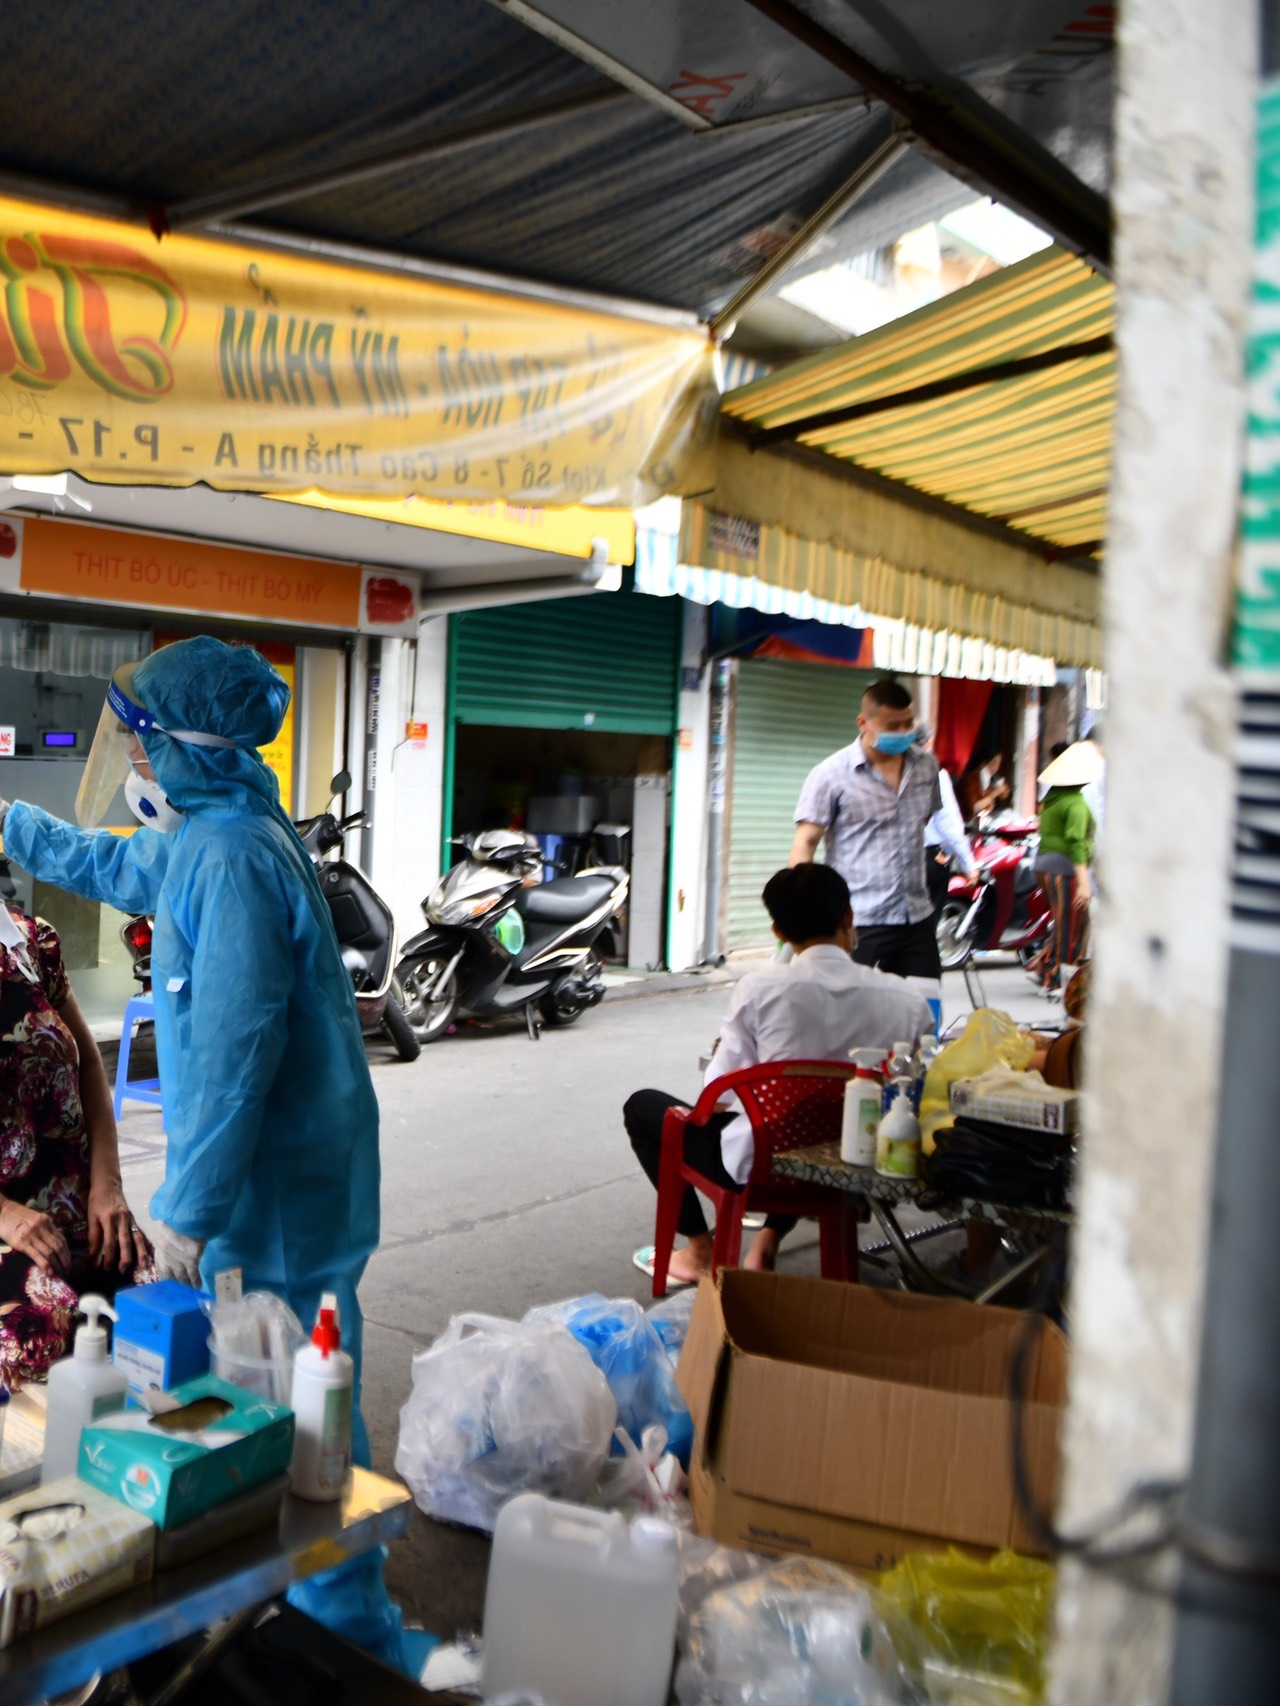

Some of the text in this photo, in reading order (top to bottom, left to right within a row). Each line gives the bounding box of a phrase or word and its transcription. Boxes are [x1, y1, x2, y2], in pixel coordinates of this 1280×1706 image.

[73, 551, 125, 583] THỊT
[215, 571, 259, 601] THỊT
[39, 1569, 91, 1597] MERUFA
